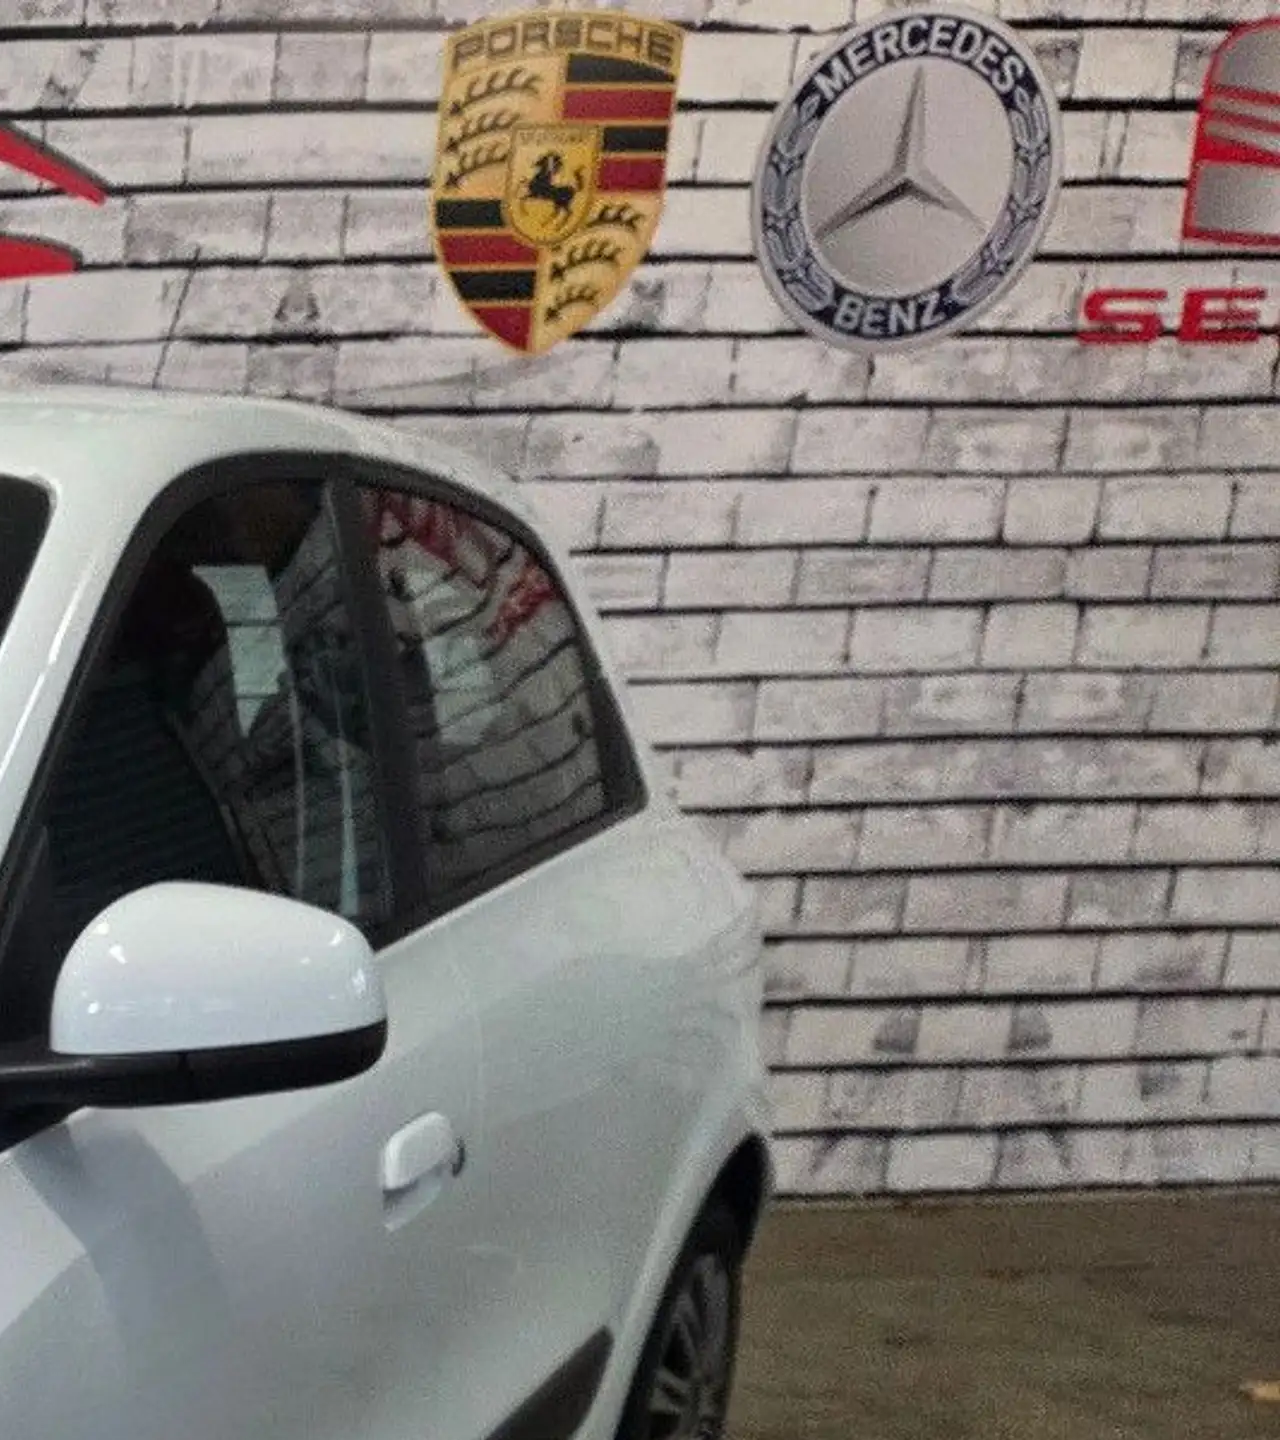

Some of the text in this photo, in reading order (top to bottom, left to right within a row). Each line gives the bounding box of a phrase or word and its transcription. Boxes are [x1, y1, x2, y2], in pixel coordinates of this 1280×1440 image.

[453, 18, 676, 71] PORSCHE
[814, 17, 1026, 101] MERCEDES
[833, 290, 947, 334] BENZ
